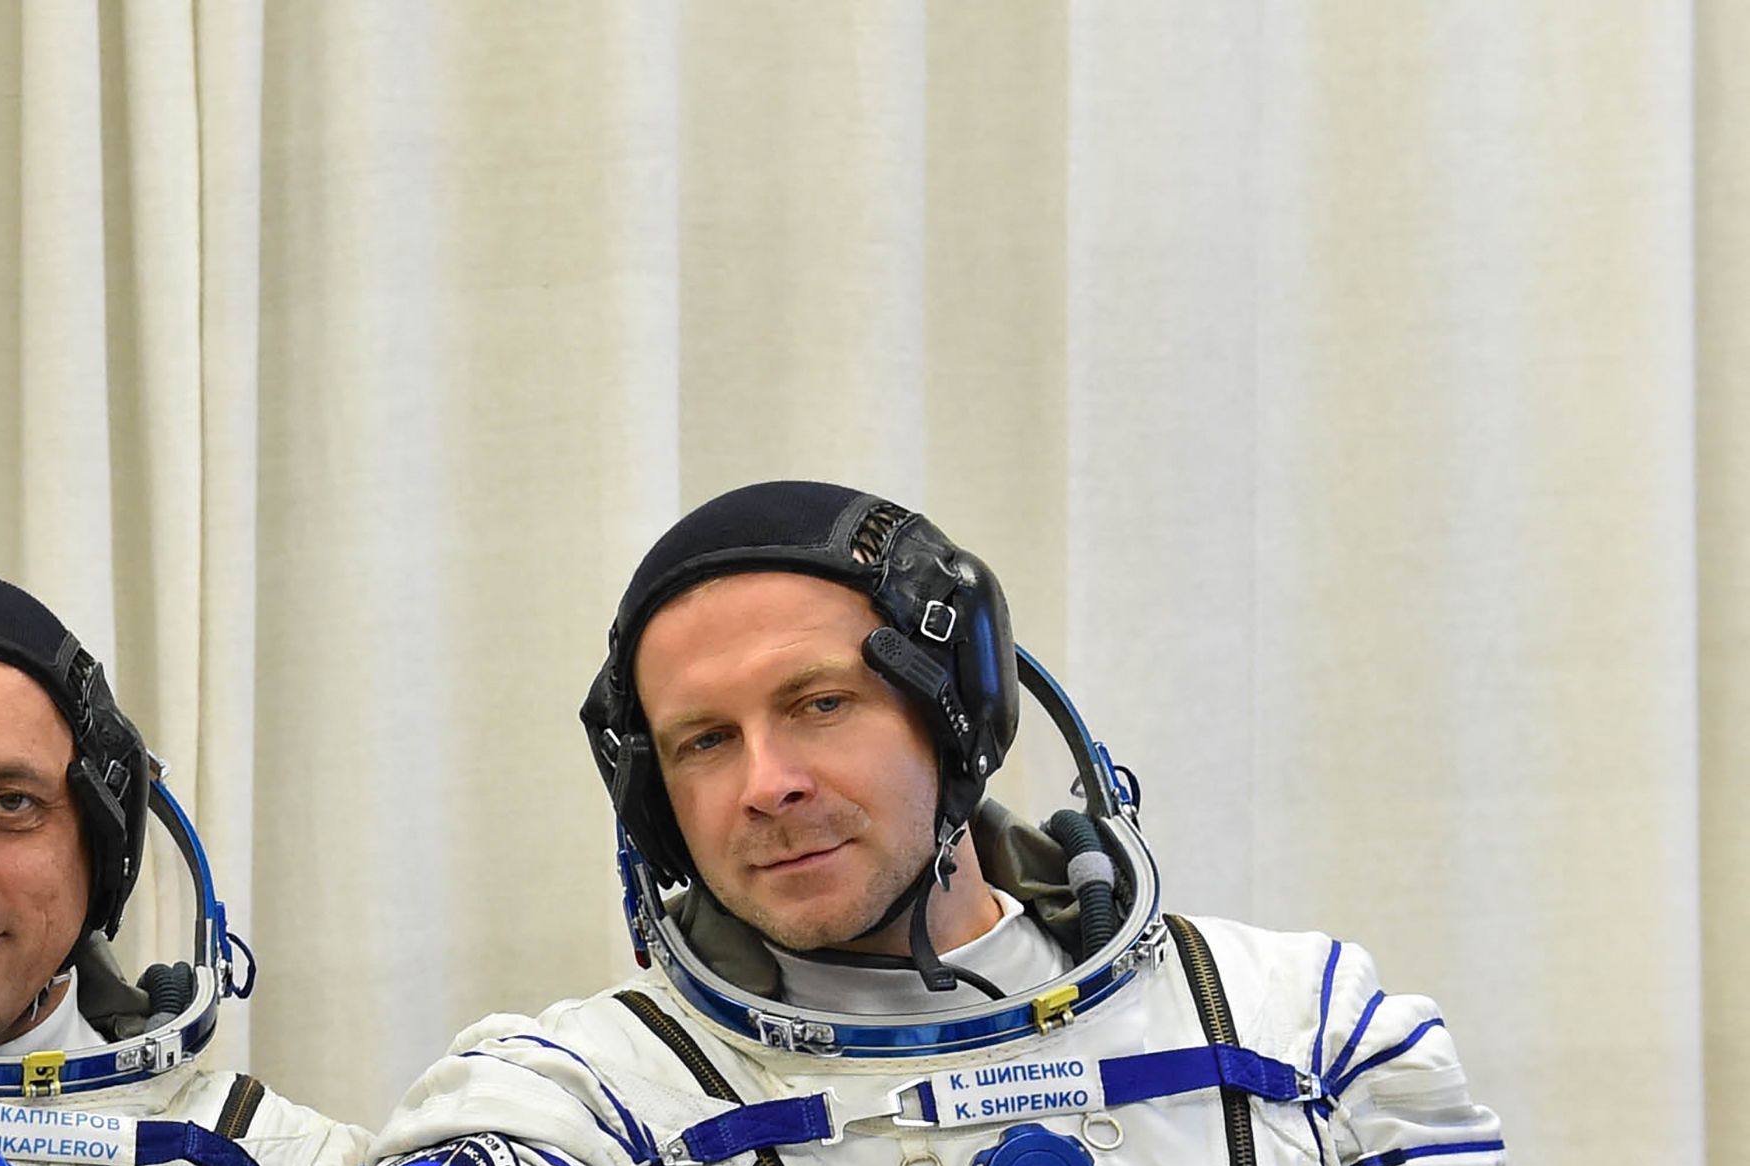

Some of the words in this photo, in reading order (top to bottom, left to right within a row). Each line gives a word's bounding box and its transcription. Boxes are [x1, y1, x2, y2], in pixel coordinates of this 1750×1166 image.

[950, 1073, 970, 1090] К.
[975, 1060, 1084, 1087] ШИПЕНКО
[955, 1102, 976, 1120] K.
[981, 1090, 1089, 1116] SHIPENKO
